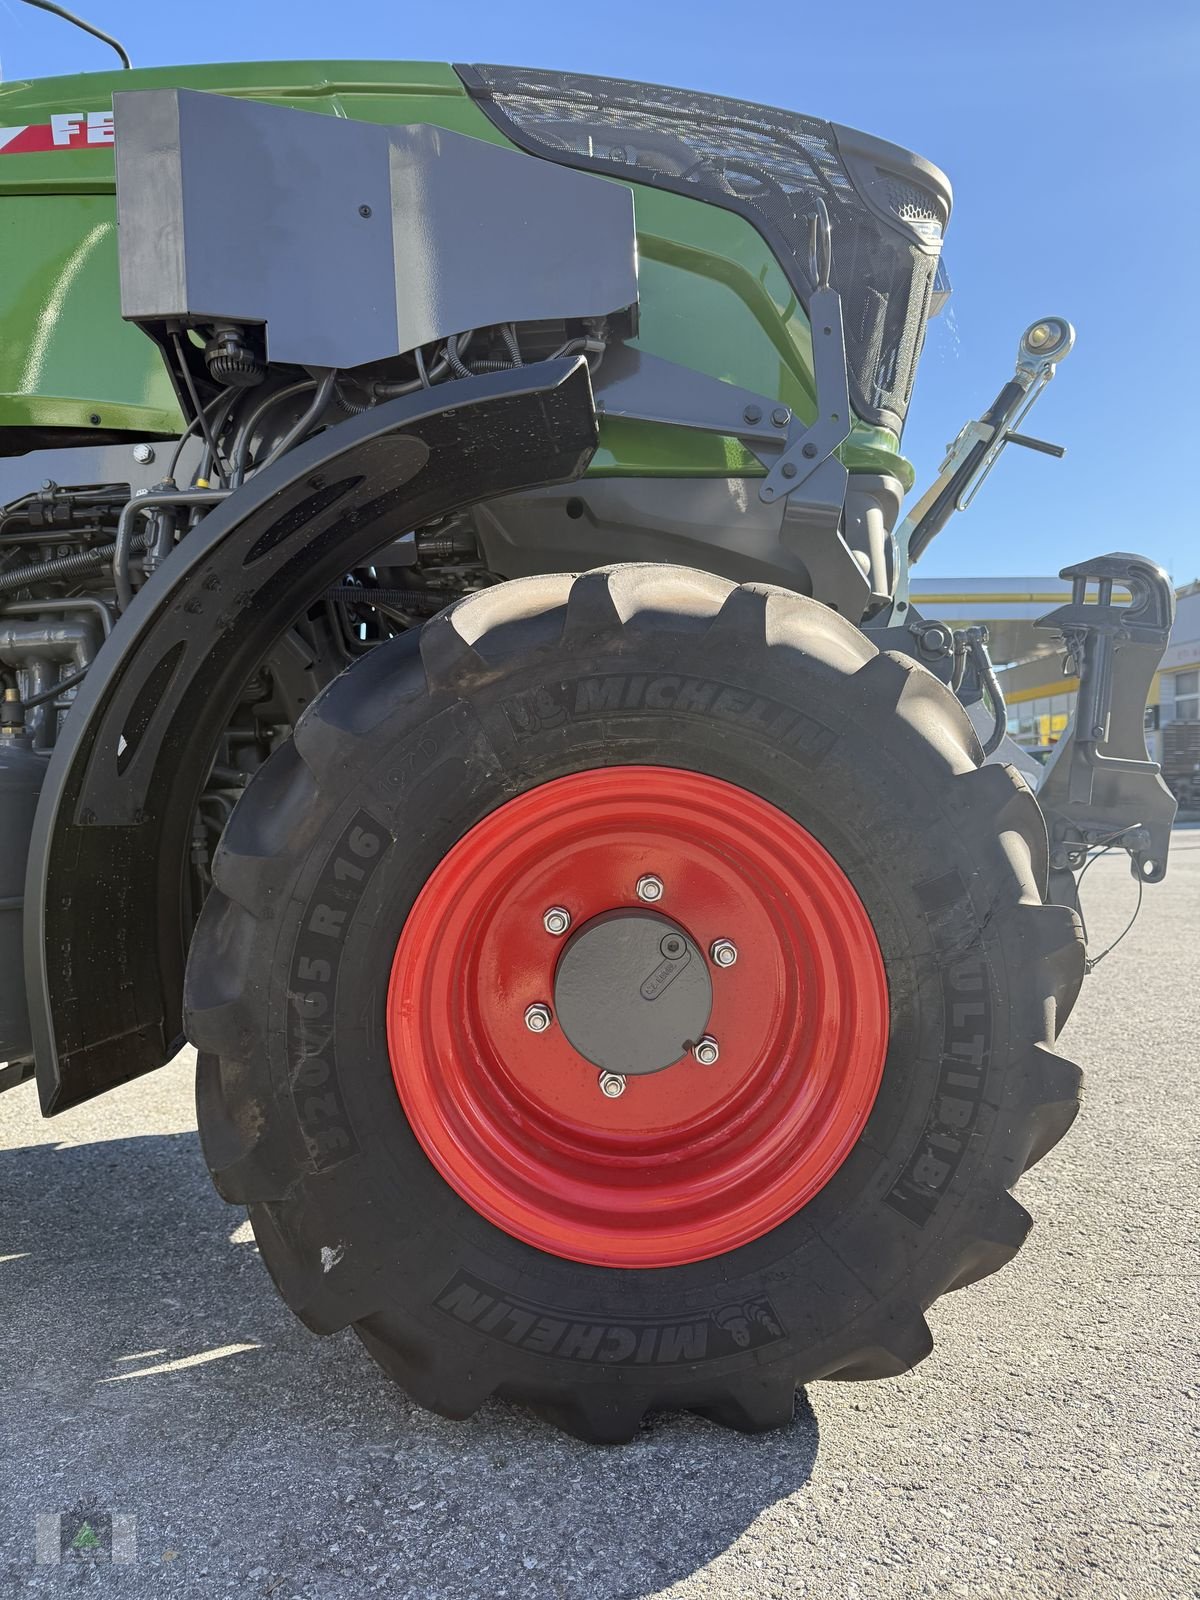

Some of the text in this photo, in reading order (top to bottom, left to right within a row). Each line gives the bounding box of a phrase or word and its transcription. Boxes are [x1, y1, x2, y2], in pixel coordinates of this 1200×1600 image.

[574, 674, 838, 762] MICHELIN
[309, 903, 348, 938] R
[334, 827, 381, 881] 16
[913, 908, 985, 1187] ULTIBIB
[438, 1283, 706, 1362] MICHELIN
